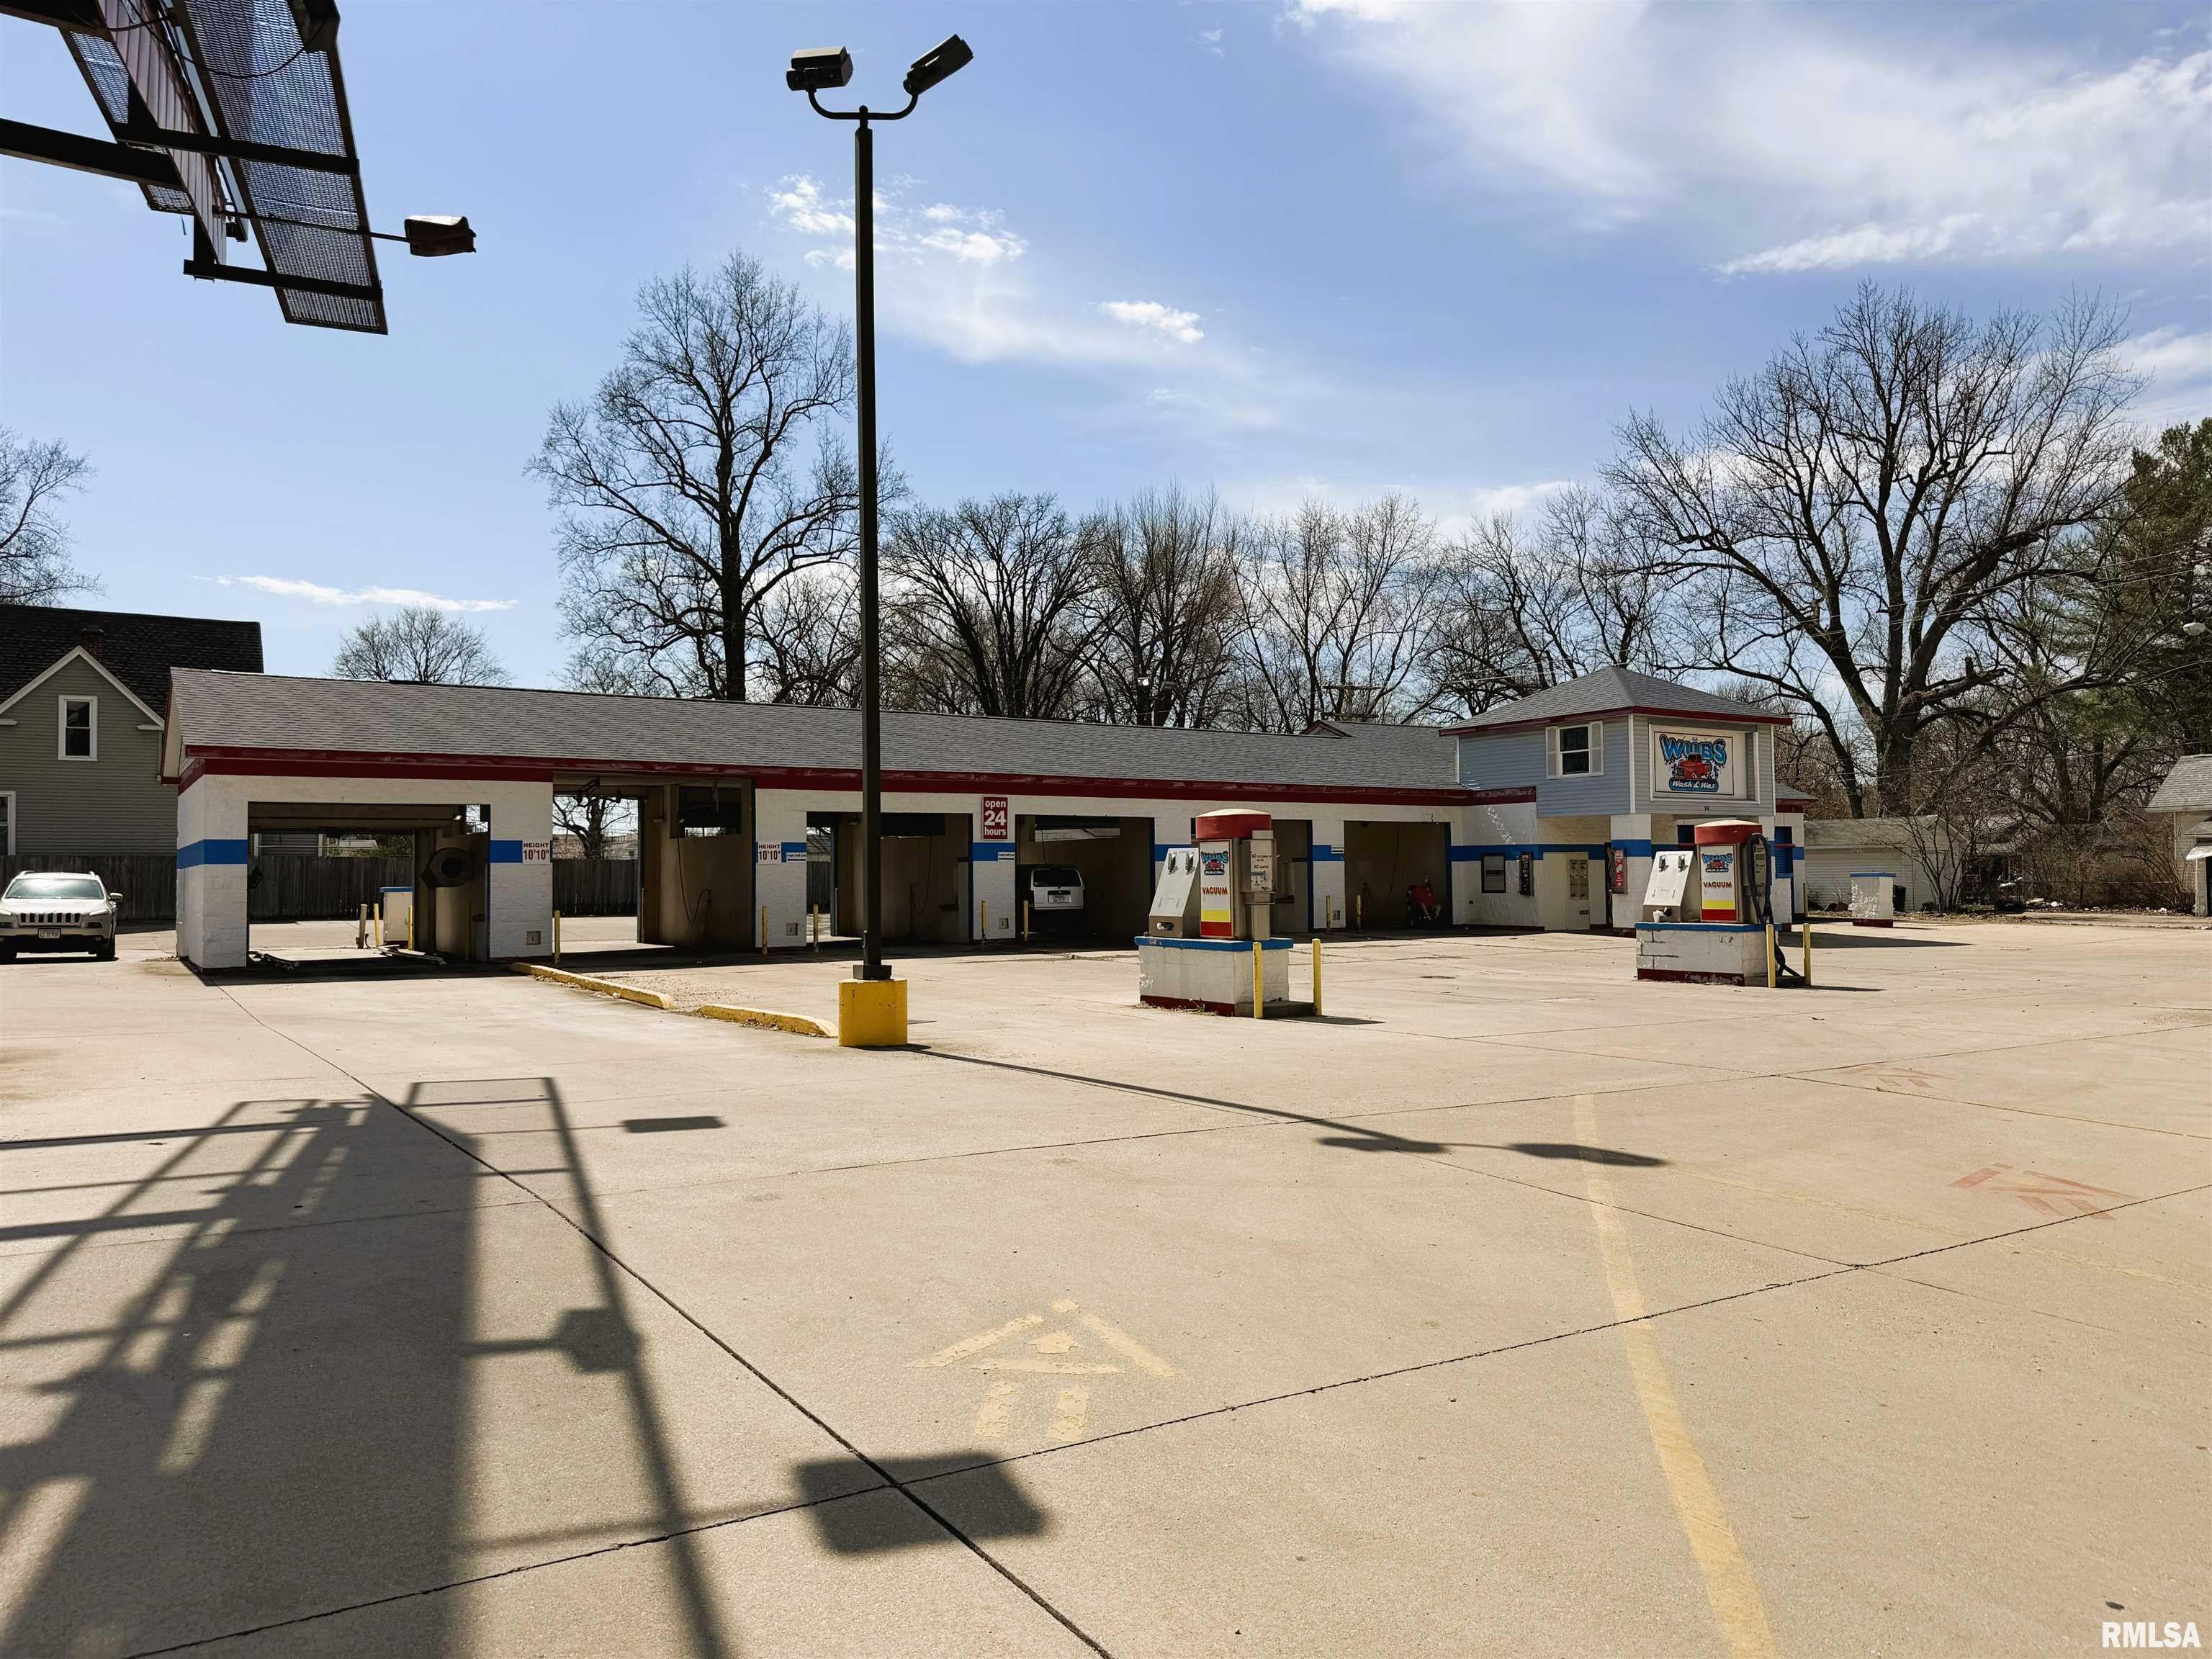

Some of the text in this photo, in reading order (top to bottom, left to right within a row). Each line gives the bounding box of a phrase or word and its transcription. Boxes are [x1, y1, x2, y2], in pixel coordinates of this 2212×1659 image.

[1659, 734, 1727, 765] WUBS
[985, 800, 1006, 809] open
[984, 810, 1007, 826] 24
[984, 827, 1006, 836] hours
[523, 850, 549, 860] 10'10"
[759, 850, 781, 860] 10'10"
[1202, 886, 1228, 895] VACUUM
